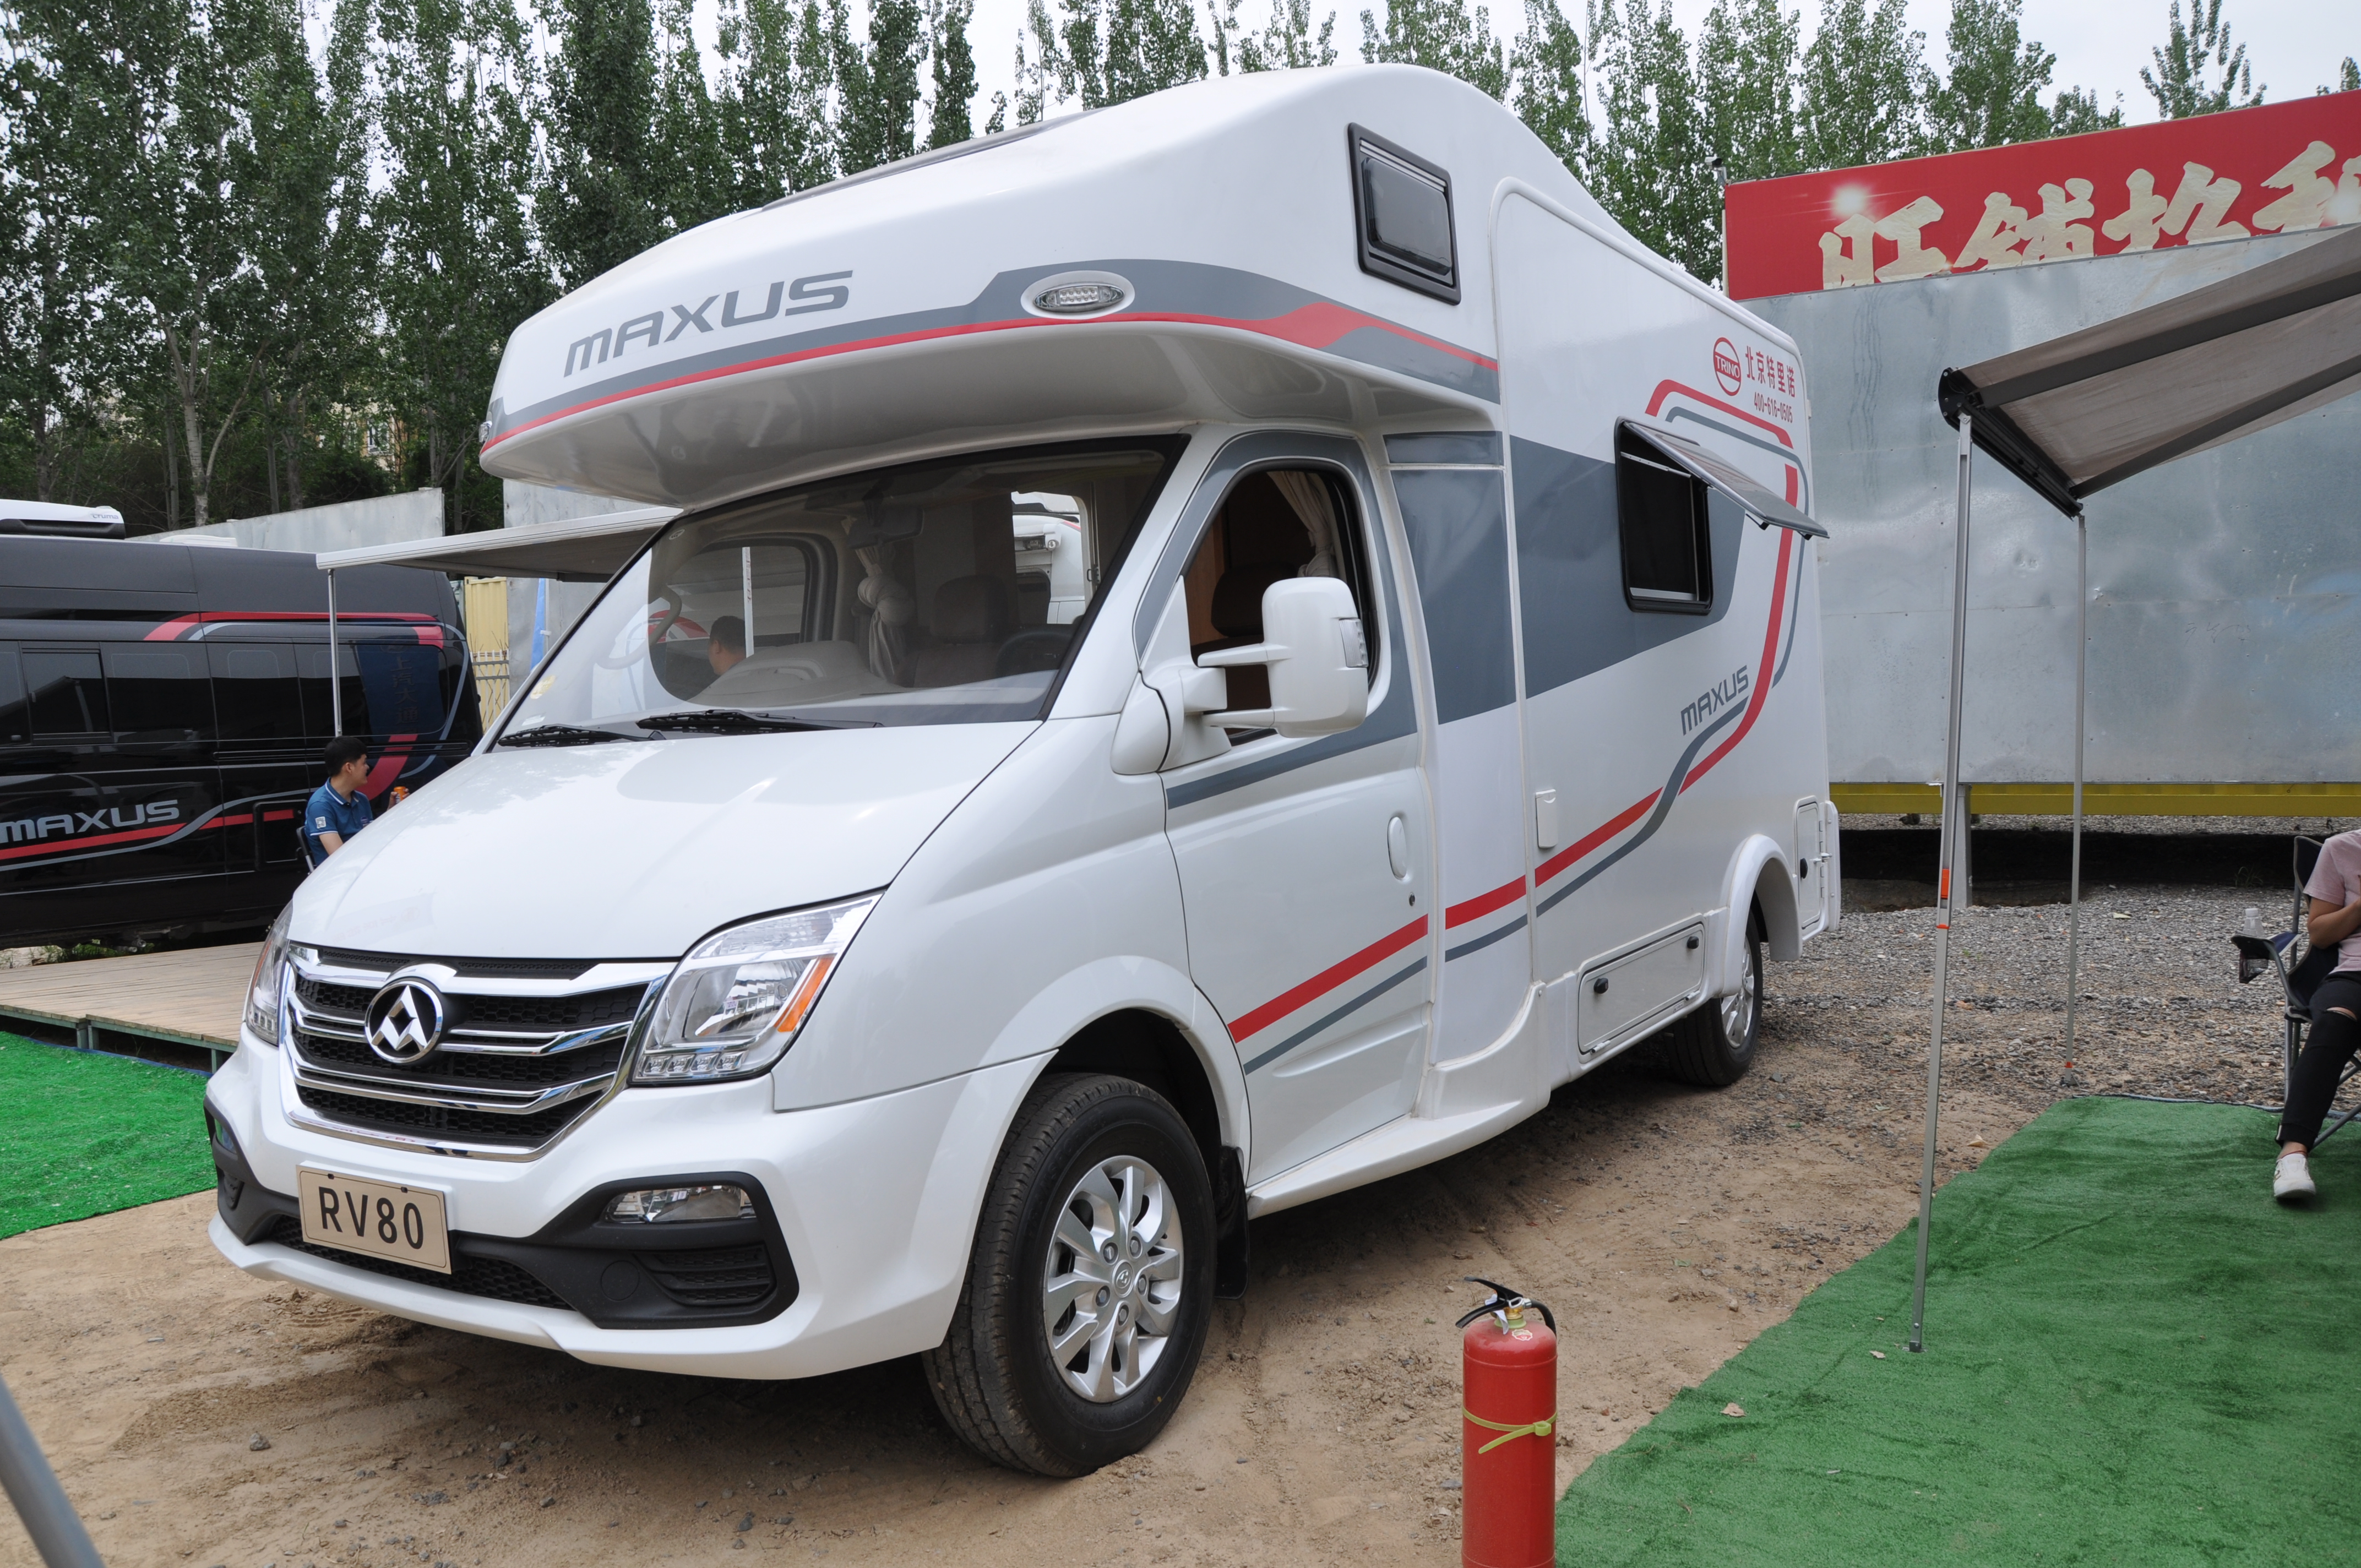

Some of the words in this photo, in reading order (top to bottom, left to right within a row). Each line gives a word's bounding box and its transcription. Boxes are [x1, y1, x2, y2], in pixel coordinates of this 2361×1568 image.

[563, 270, 853, 378] MAXUS
[1715, 355, 1740, 378] TRINO
[1745, 345, 1795, 398] 北京特里诺
[1754, 391, 1793, 423] 400-616-0505
[1680, 665, 1749, 736] MAXUS
[0, 799, 179, 843] MAXUS
[318, 1186, 423, 1250] RV80
